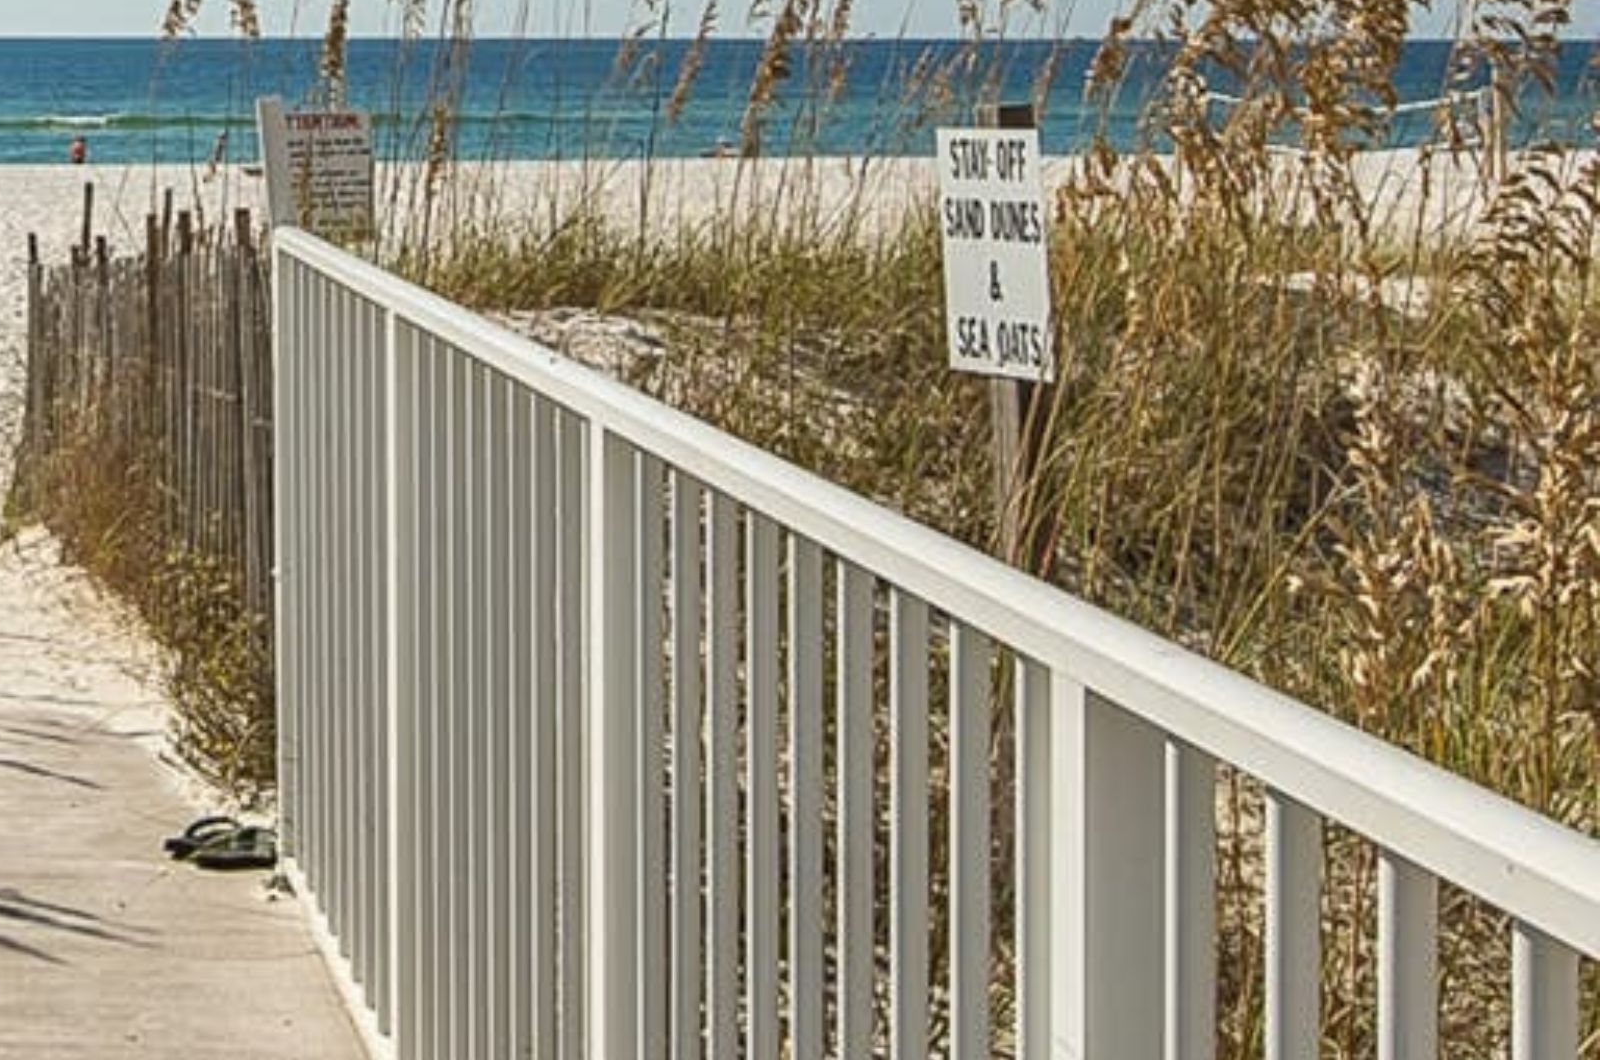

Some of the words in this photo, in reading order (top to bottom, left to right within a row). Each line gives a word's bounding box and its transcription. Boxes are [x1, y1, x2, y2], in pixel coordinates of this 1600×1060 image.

[997, 138, 1026, 182] OFF
[945, 198, 984, 238] SAND
[990, 201, 1041, 243] DUNES
[989, 260, 1003, 301] &
[957, 318, 990, 360] SEA
[997, 325, 1042, 367] OATS
